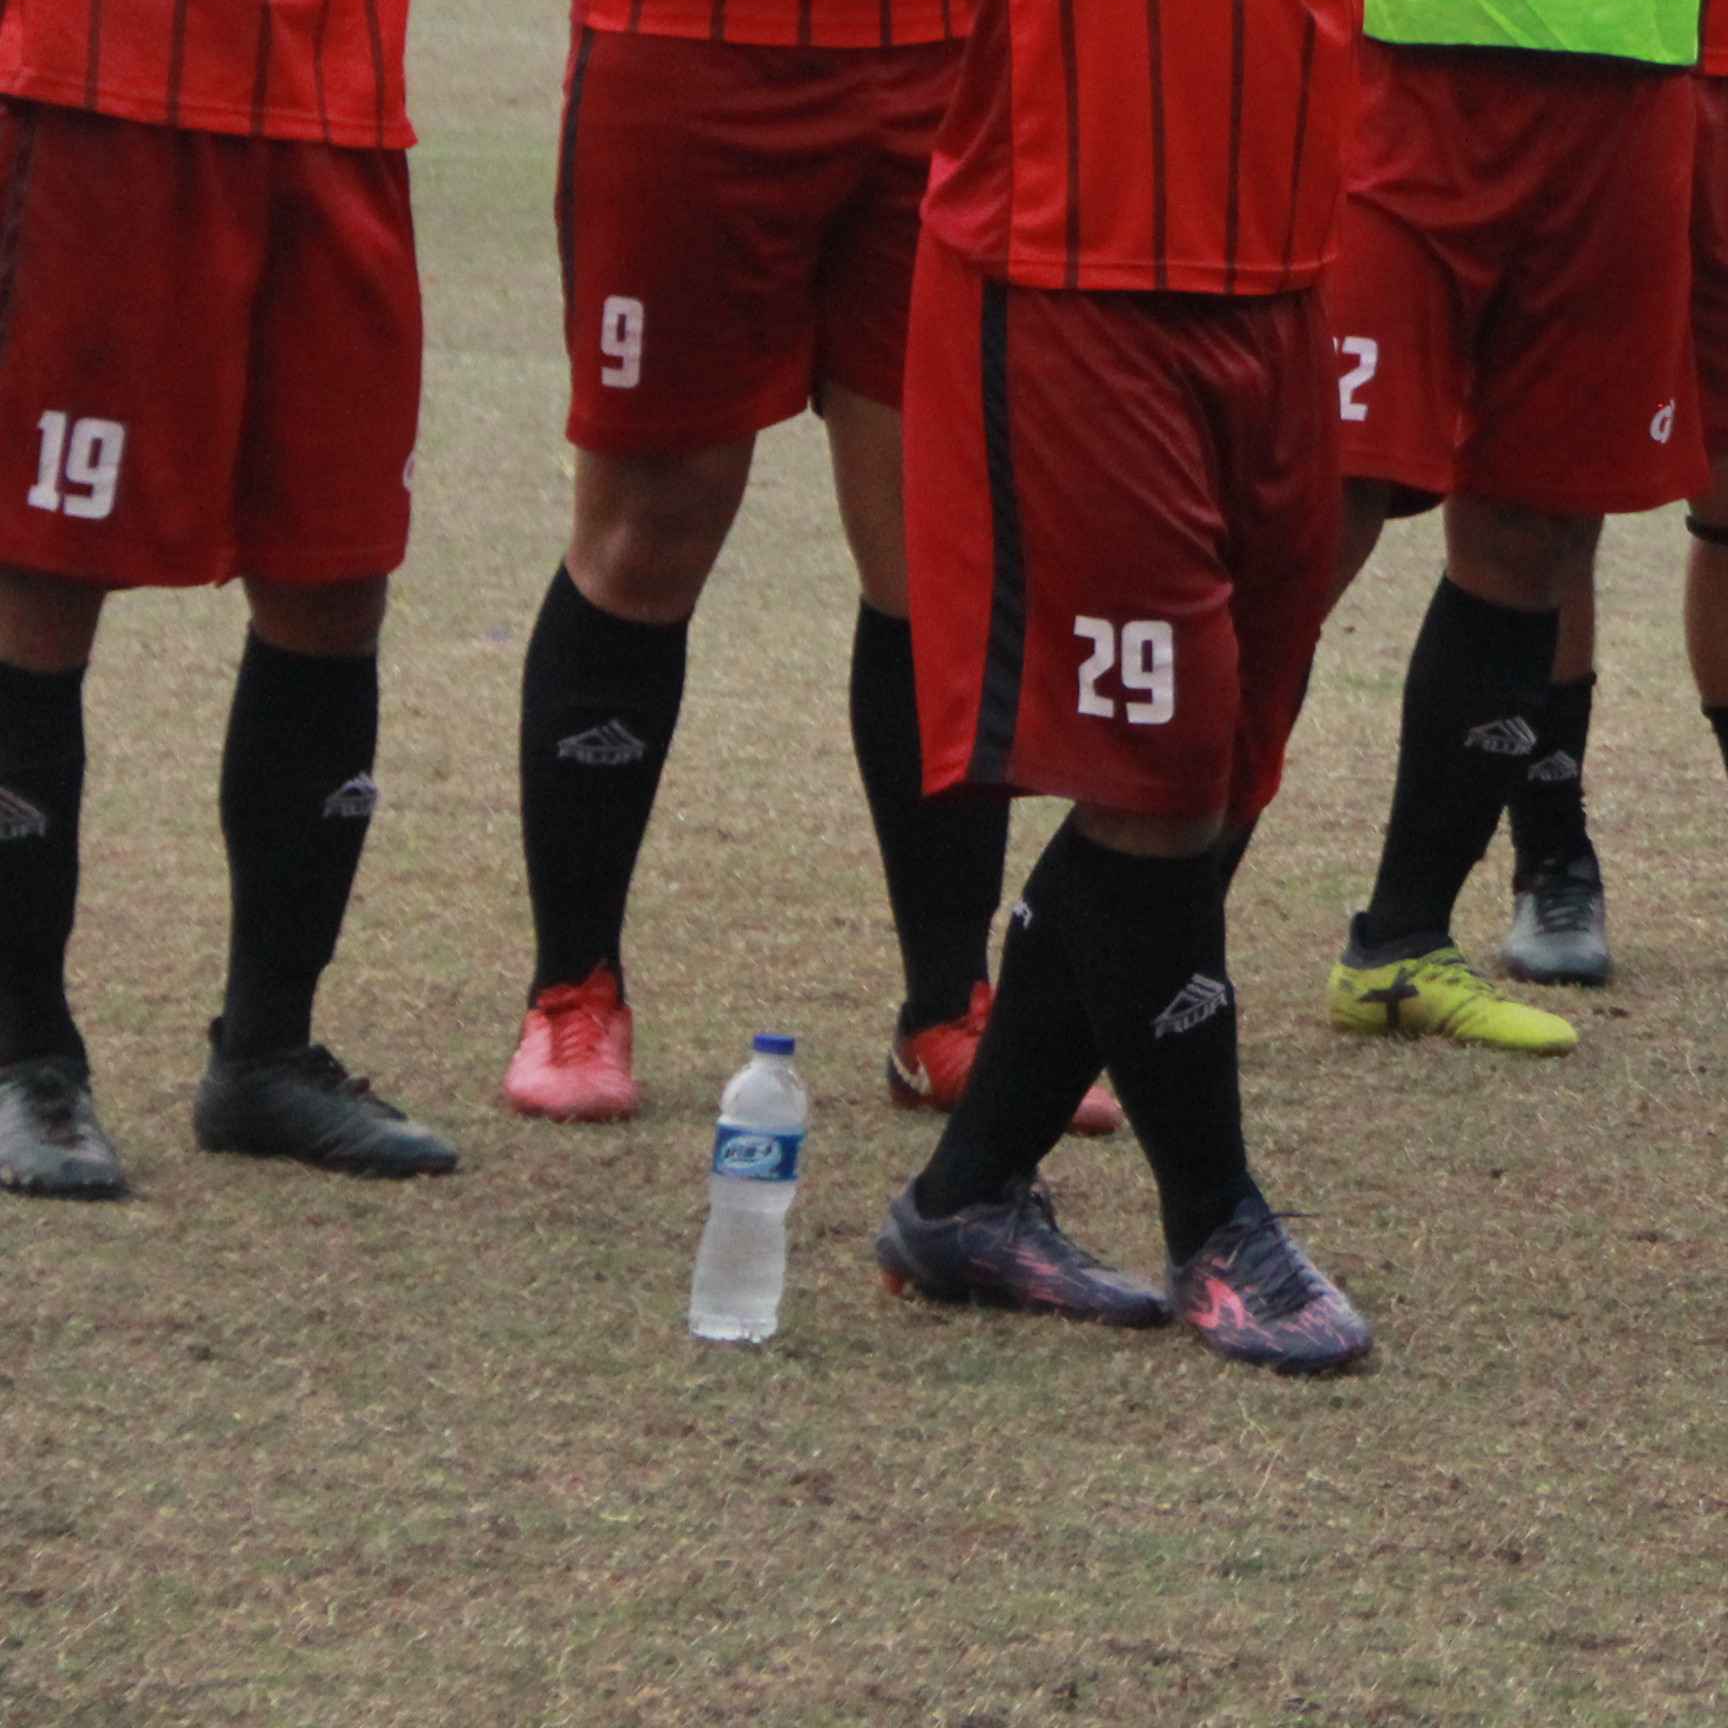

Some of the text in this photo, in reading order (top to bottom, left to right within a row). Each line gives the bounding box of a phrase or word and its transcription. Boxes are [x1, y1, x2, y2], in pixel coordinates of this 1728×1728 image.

[601, 295, 645, 389] 9
[26, 410, 126, 520] 19
[1072, 615, 1176, 725] 29
